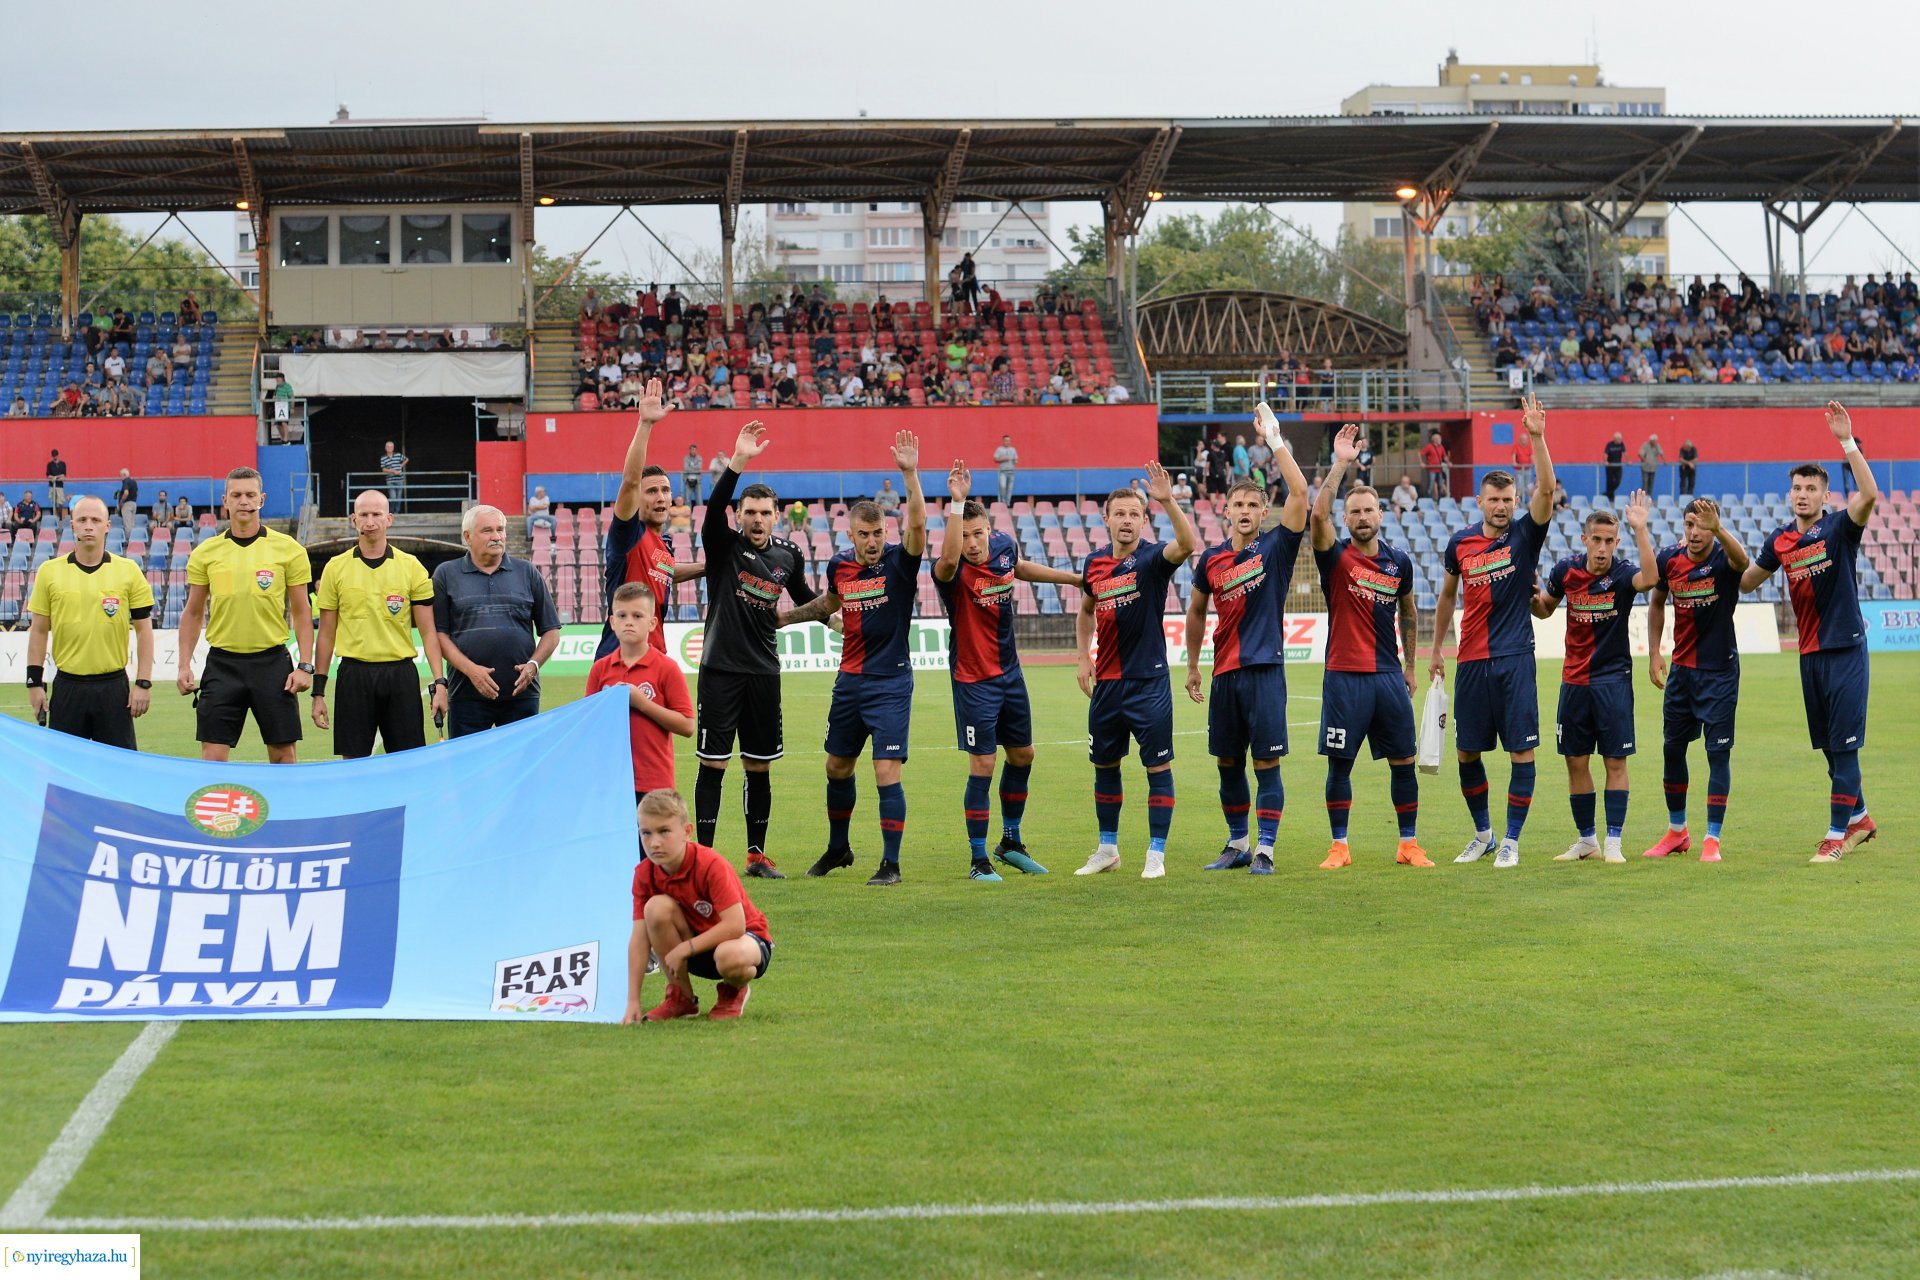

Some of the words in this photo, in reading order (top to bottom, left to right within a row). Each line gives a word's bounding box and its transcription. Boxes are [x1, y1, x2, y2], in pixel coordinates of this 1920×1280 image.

[278, 409, 286, 418] A
[1881, 610, 1920, 629] BR
[1884, 634, 1920, 644] ALKAT
[701, 728, 708, 750] 1
[966, 725, 976, 747] 8
[1326, 726, 1347, 749] 23
[1157, 748, 1169, 757] JAKO
[87, 841, 120, 880] A
[130, 854, 351, 891] GYŰLÖLET
[67, 879, 347, 974] NEM
[503, 951, 591, 984] FAIR
[501, 968, 591, 1000] PLAY
